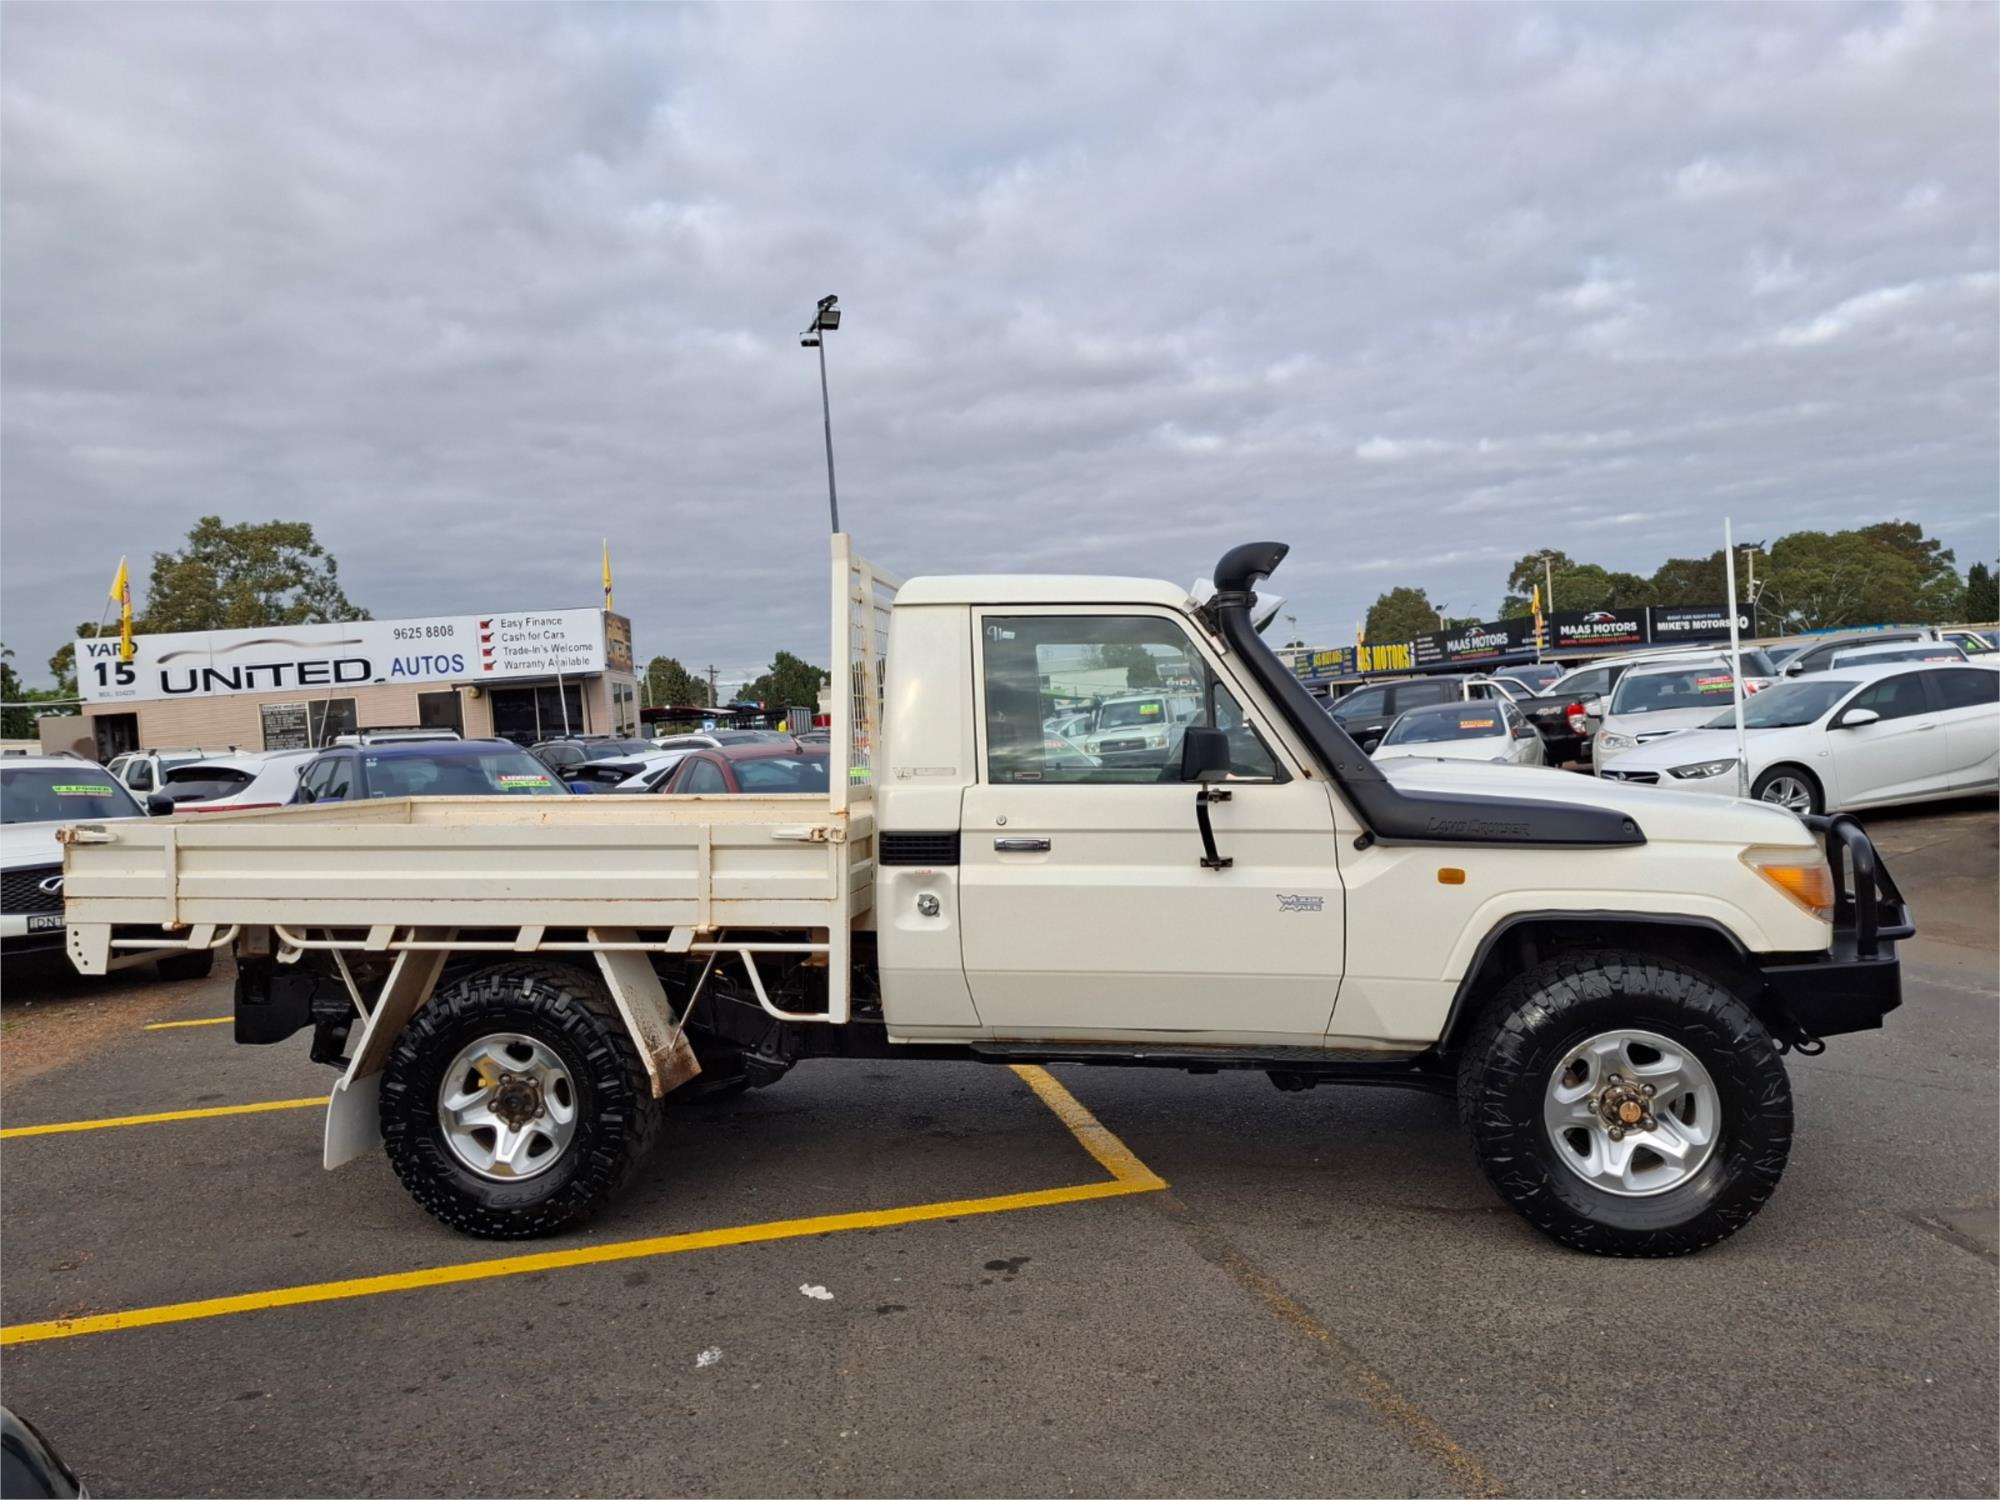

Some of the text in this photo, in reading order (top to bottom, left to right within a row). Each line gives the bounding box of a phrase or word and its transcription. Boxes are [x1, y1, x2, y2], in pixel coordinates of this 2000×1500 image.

[500, 617, 563, 629] Easy Finance
[1560, 622, 1637, 635] MAAS MOTORS
[1657, 619, 1731, 631] MIKE'S MOTORS
[393, 625, 454, 640] 9625 8808
[501, 630, 565, 642] Cash for Cars
[1447, 638, 1471, 652] MAAS
[1472, 632, 1509, 648] MOTORS
[503, 643, 593, 656] Trade-In's Welcome
[504, 658, 545, 670] Warranty
[1372, 644, 1410, 671] MOTORS
[391, 653, 464, 676] AUTOS
[94, 661, 136, 686] 15
